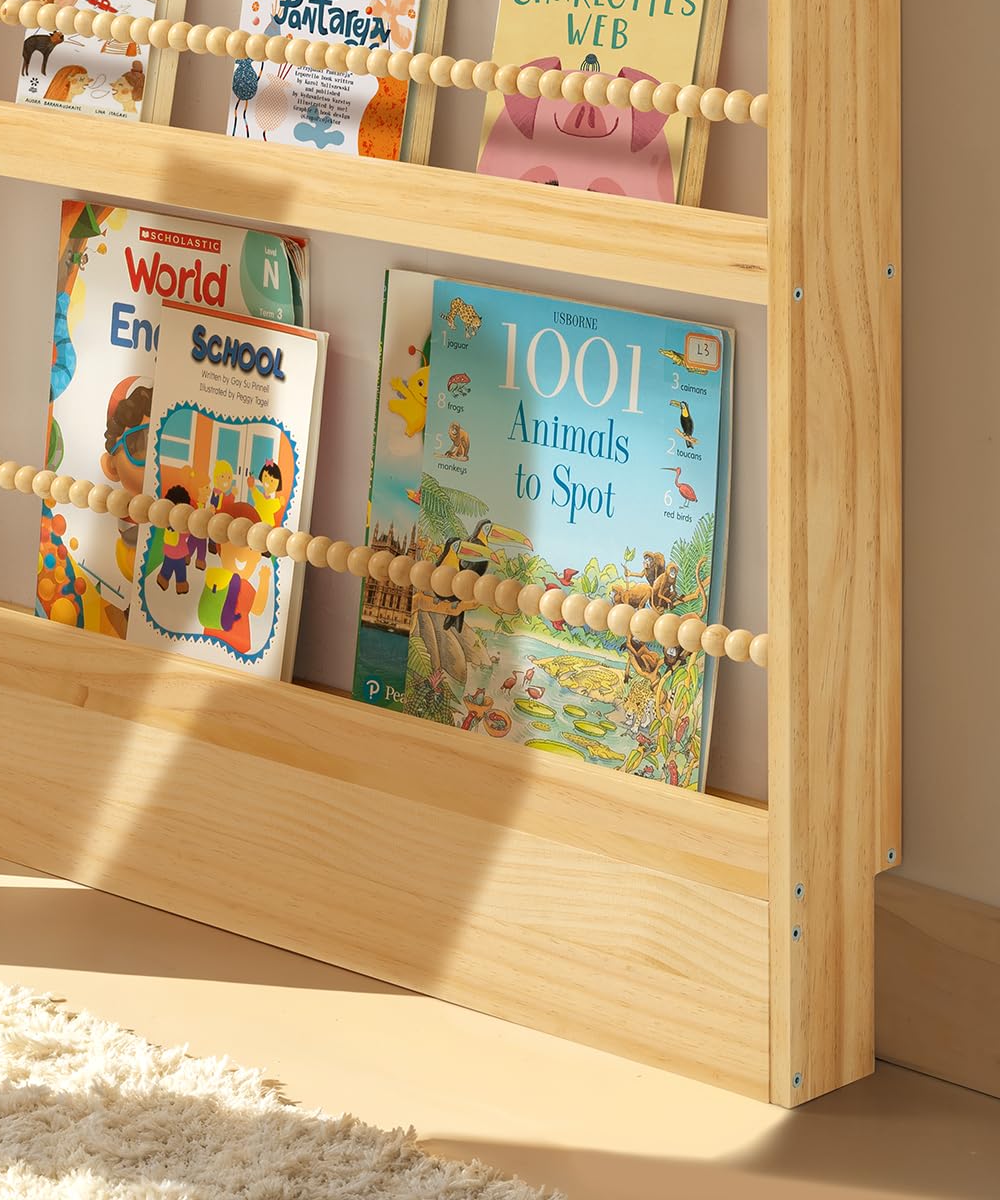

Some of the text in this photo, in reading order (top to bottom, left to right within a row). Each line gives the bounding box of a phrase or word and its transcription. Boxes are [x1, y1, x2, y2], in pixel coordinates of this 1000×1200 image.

[567, 12, 629, 50] WEB
[150, 230, 220, 251] SCHOLASTIC
[125, 246, 228, 307] World
[263, 258, 279, 290] N
[110, 302, 160, 352] En
[276, 307, 283, 320] 3
[553, 311, 598, 331] USBORNE
[191, 325, 286, 381] SCHOOL
[447, 338, 469, 350] jaguar
[498, 322, 644, 415] 1001
[671, 372, 708, 396] 3 caimans
[437, 392, 464, 414] 8 frogs
[507, 400, 630, 464] Animals
[435, 432, 468, 475] 5 monkeys
[666, 438, 702, 461] 2 toucans
[514, 463, 617, 525] to Spot
[663, 489, 672, 506] 6
[663, 510, 693, 523] red birds
